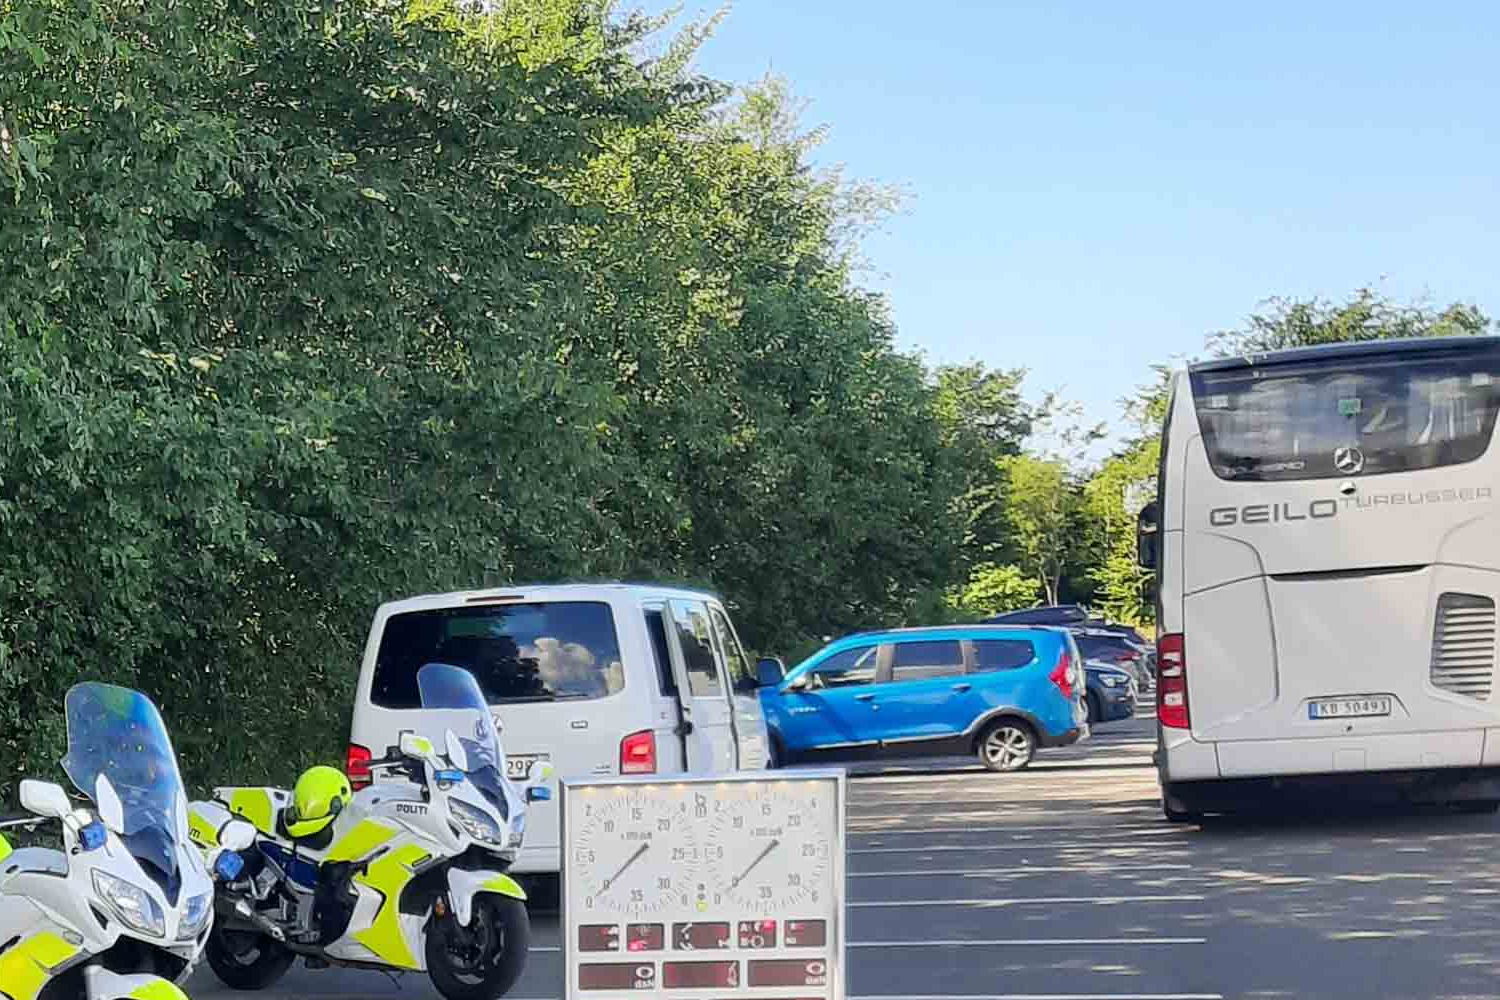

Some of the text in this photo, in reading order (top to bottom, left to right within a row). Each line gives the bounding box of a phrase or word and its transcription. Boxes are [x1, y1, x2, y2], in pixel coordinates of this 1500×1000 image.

[1340, 486, 1493, 510] TURBUSSER
[1209, 499, 1338, 527] GEILO
[396, 803, 428, 815] POLITI
